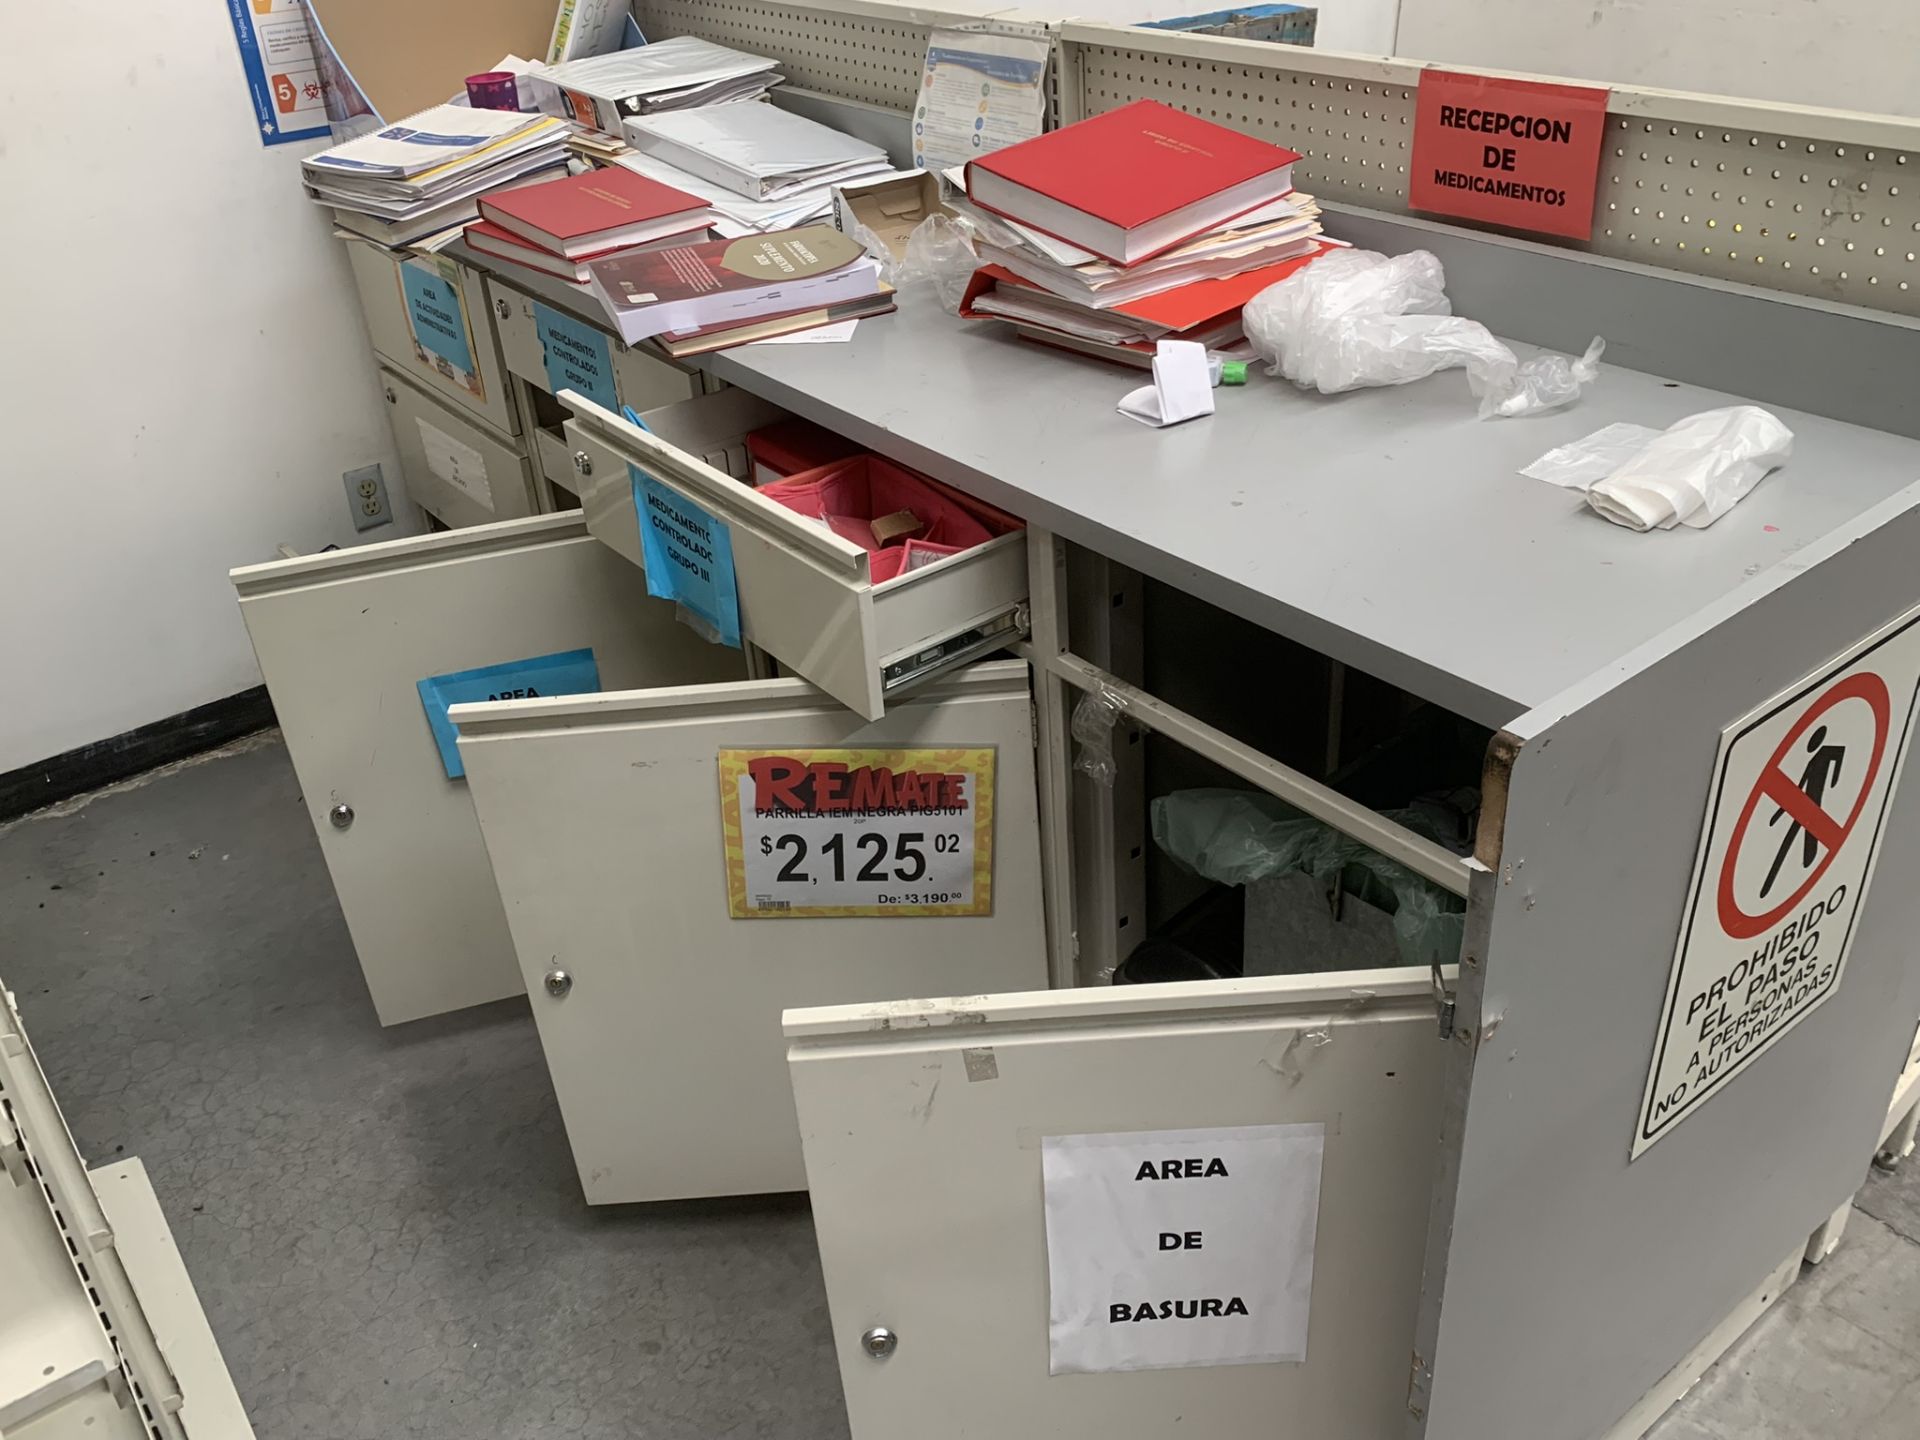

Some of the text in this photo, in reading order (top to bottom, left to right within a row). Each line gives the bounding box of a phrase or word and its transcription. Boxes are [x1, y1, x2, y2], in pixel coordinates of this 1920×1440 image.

[278, 84, 291, 100] 5
[1440, 105, 1572, 144] RECEPCION
[1483, 145, 1516, 172] DE
[1434, 169, 1566, 207] MEDICAMENTOS
[760, 241, 795, 273] SUPLEMENTO
[548, 327, 596, 359] MEDICAMENTOS
[553, 346, 598, 376] CONTROLADOS
[565, 369, 588, 389] GRUPO
[667, 547, 710, 583] GRUPO III
[748, 756, 968, 812] REMATE
[755, 807, 825, 819] PARRILLA
[828, 806, 853, 818] IEM
[857, 806, 906, 818] NEGRA
[878, 894, 901, 904] De:
[1686, 884, 1846, 1026] PROHIBIDO
[1698, 931, 1820, 1043] EL PASO
[1685, 956, 1818, 1074] A PERSONAS
[1654, 964, 1833, 1120] NO AUTORIZADAS
[1135, 1158, 1229, 1180] AREA
[1159, 1231, 1203, 1250] DE
[1110, 1297, 1249, 1323] BASURA
